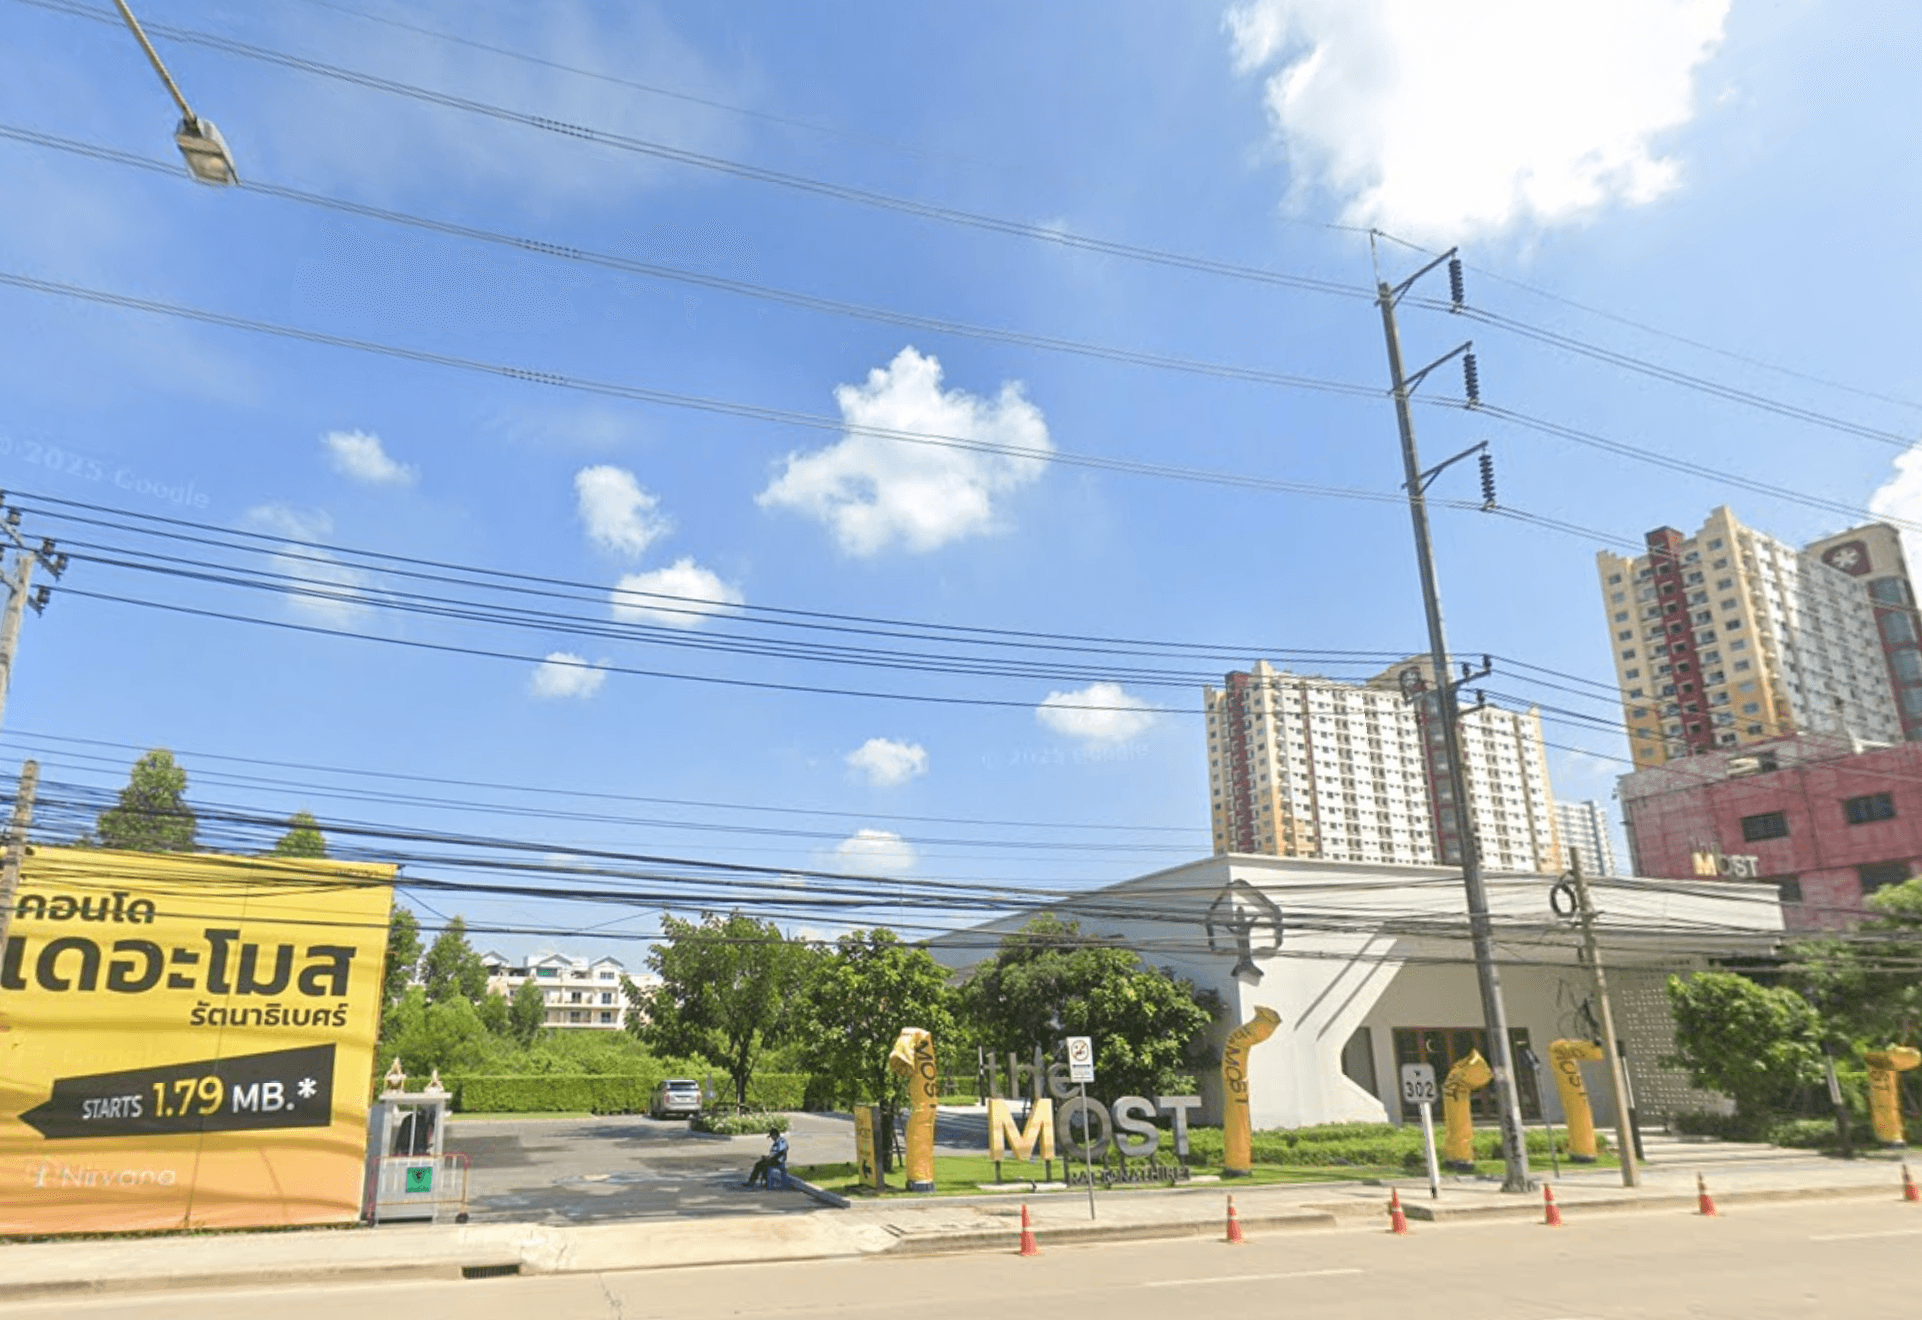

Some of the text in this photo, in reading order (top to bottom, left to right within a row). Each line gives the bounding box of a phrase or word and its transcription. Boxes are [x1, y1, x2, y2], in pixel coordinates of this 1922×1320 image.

[1692, 851, 1759, 878] MOST
[15, 891, 156, 924] คอนโด
[0, 928, 358, 998] เดอะโมส
[189, 1001, 350, 1027] รัตนาธิเบศร์
[915, 1039, 939, 1109] MOS
[983, 1050, 1083, 1099] the
[1405, 1080, 1434, 1098] 302
[81, 1094, 144, 1120] STARTS
[152, 1075, 225, 1119] 1.79
[984, 1095, 1203, 1163] MOST
